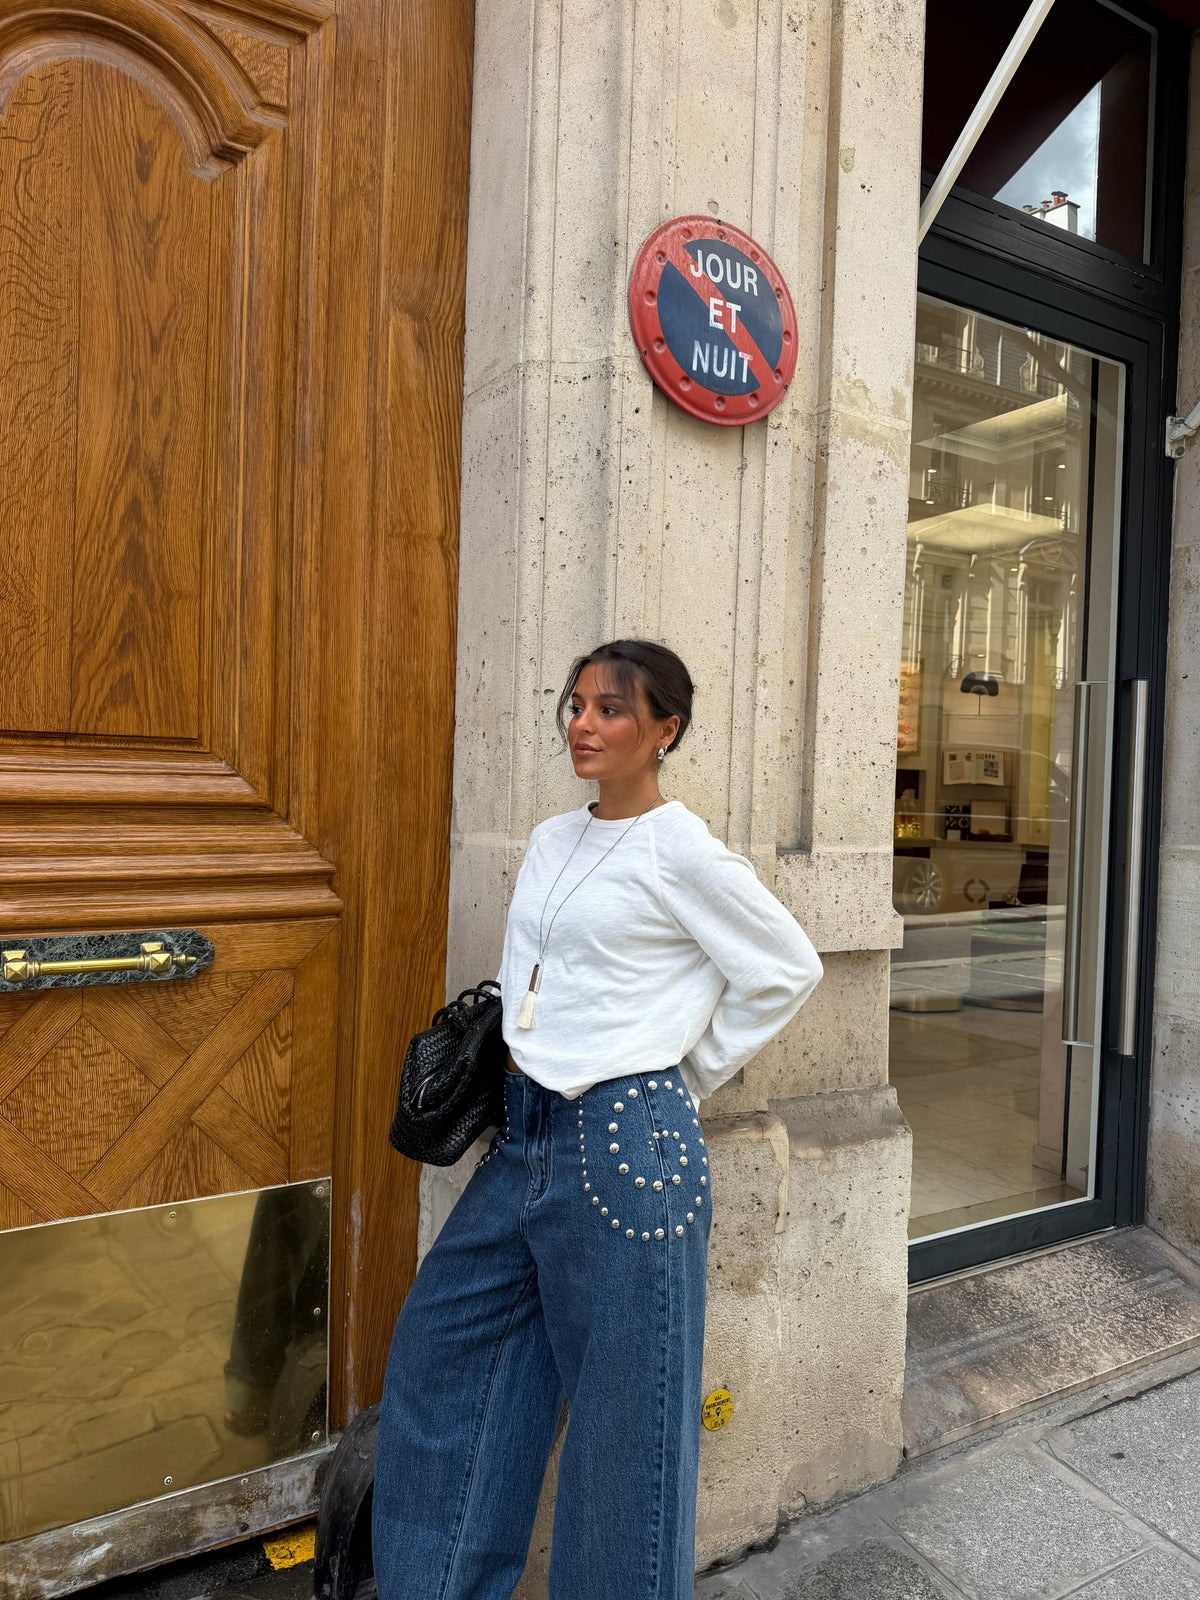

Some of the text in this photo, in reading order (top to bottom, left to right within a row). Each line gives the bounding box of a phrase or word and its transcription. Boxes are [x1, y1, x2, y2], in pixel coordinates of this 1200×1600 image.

[689, 249, 758, 297] JOUR
[709, 296, 742, 334] ET
[691, 339, 754, 384] NUIT
